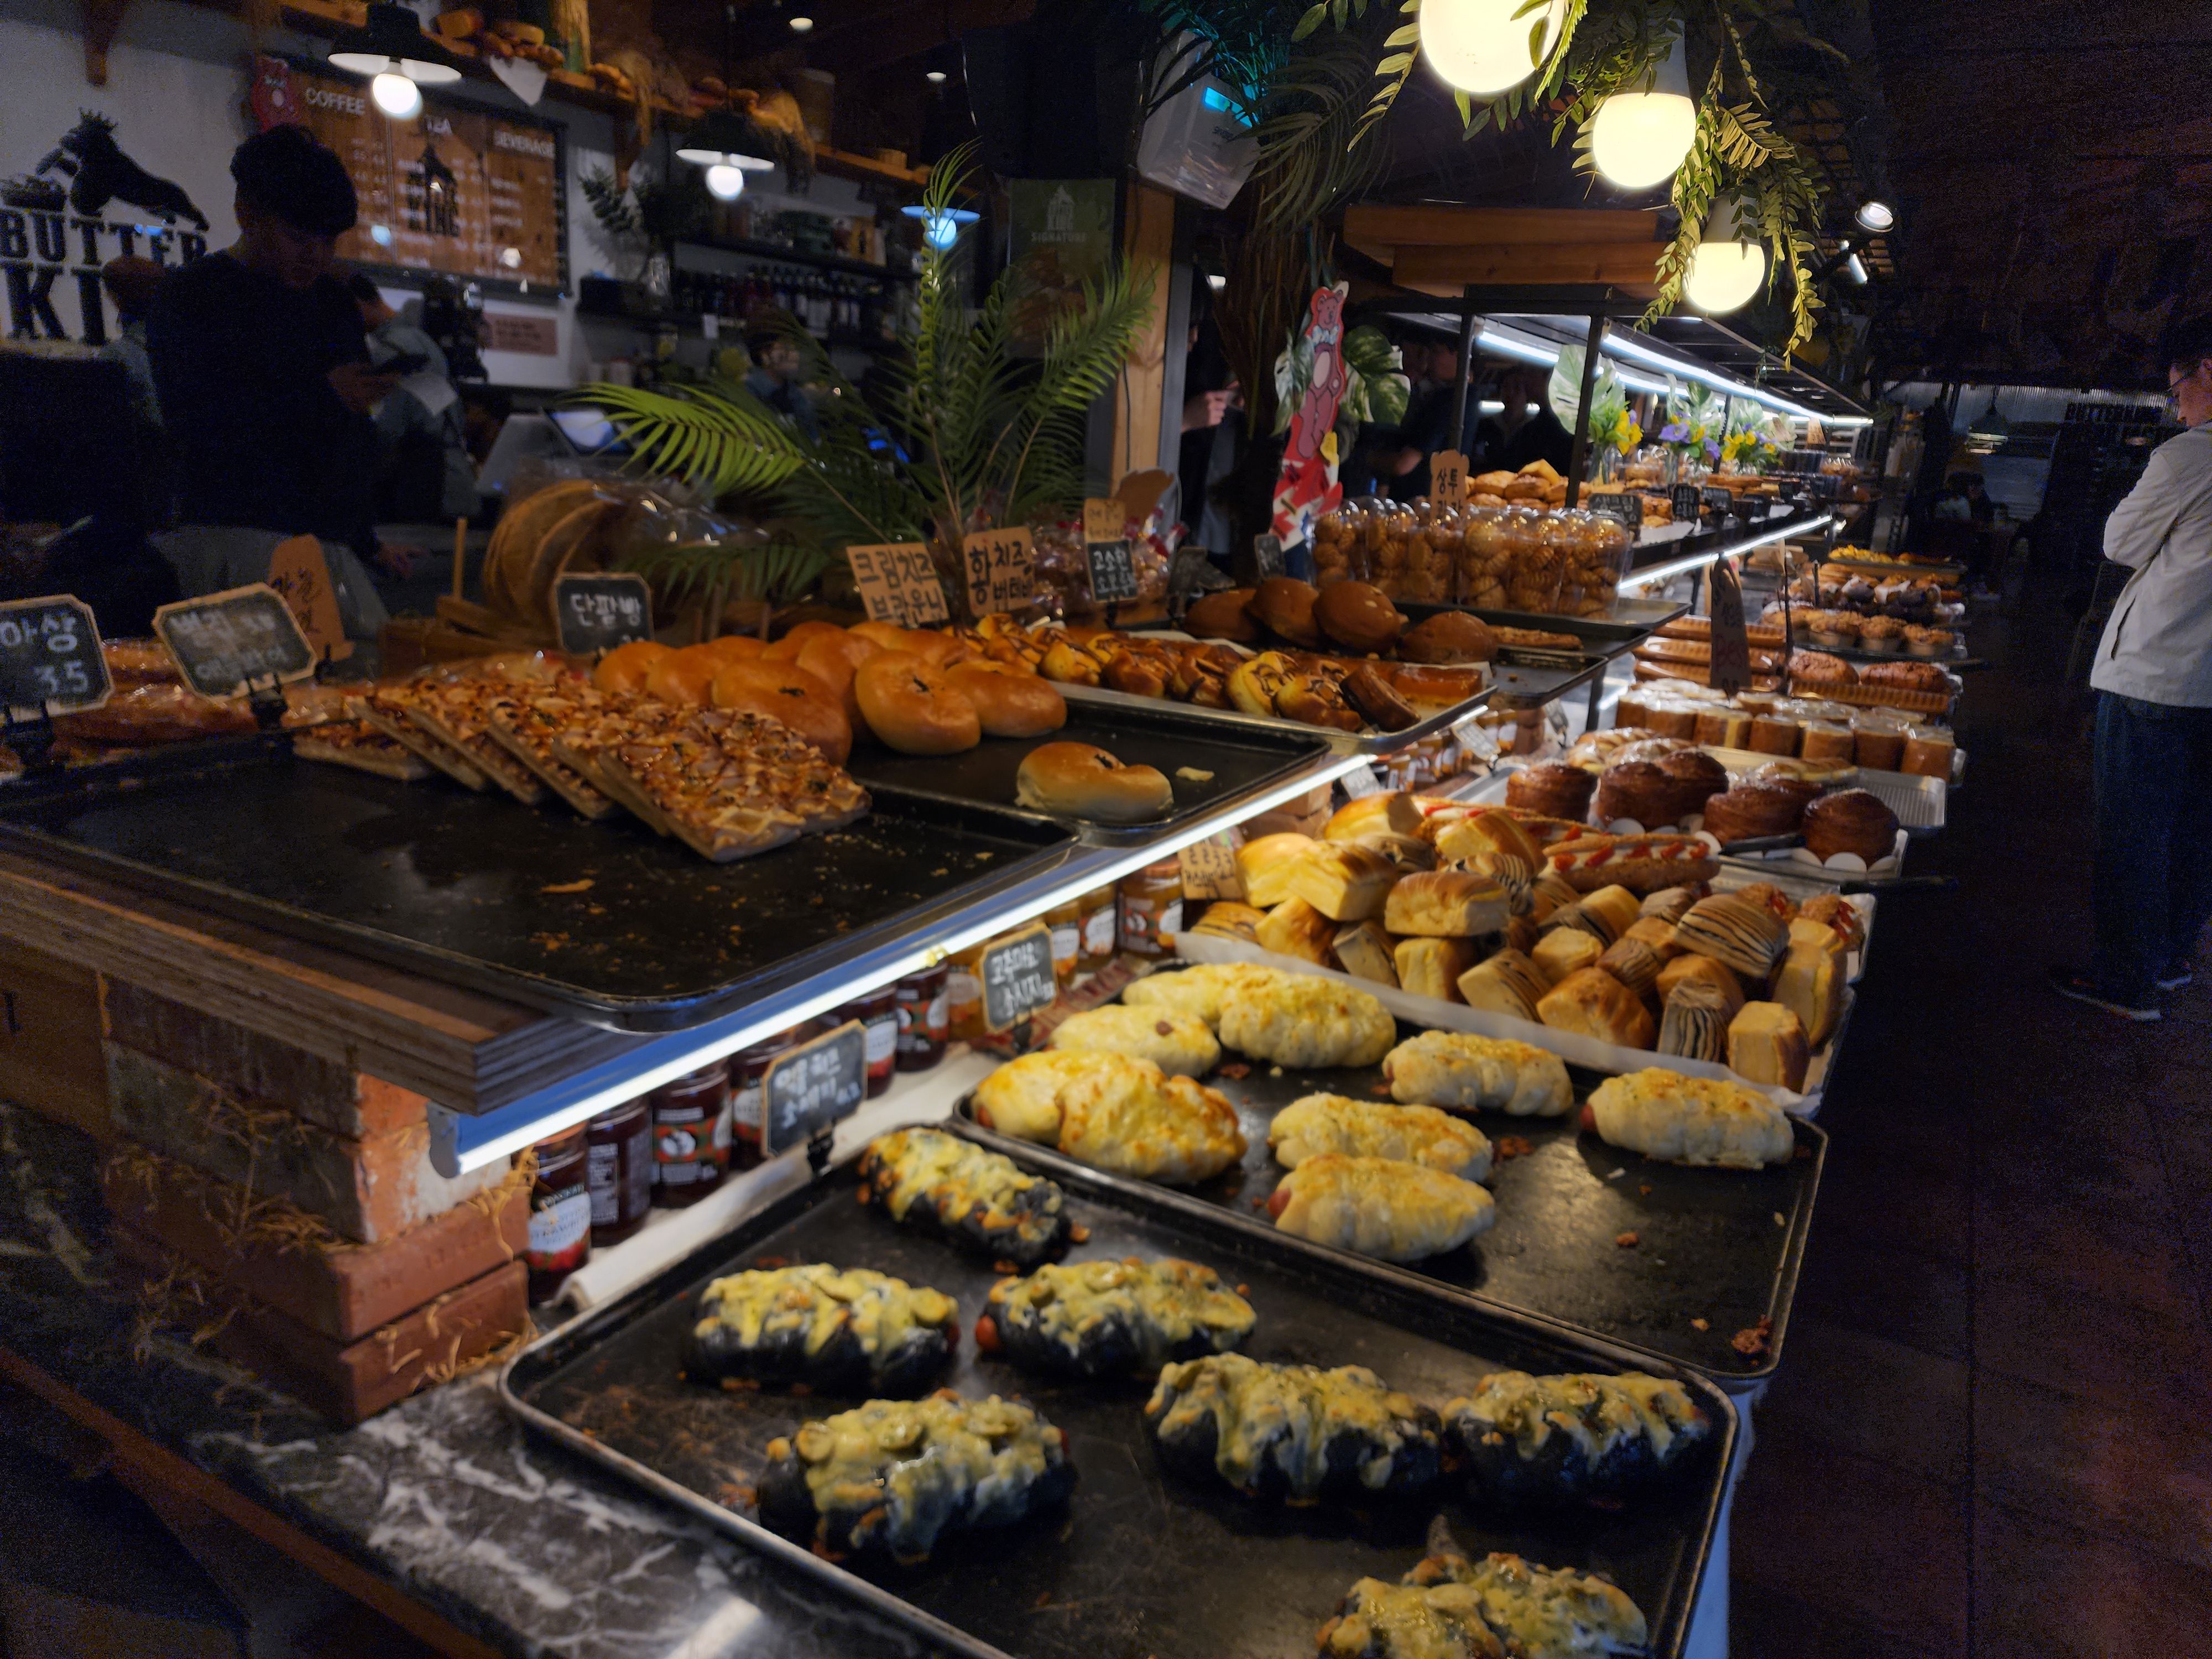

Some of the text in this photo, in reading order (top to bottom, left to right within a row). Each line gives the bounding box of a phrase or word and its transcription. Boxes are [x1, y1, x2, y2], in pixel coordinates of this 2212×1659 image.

[305, 87, 366, 116] COFFEE
[1436, 467, 1458, 496] 상투
[855, 549, 938, 588] 크림치즈
[570, 593, 642, 631] 단팥빵
[871, 588, 945, 622] 브라우니
